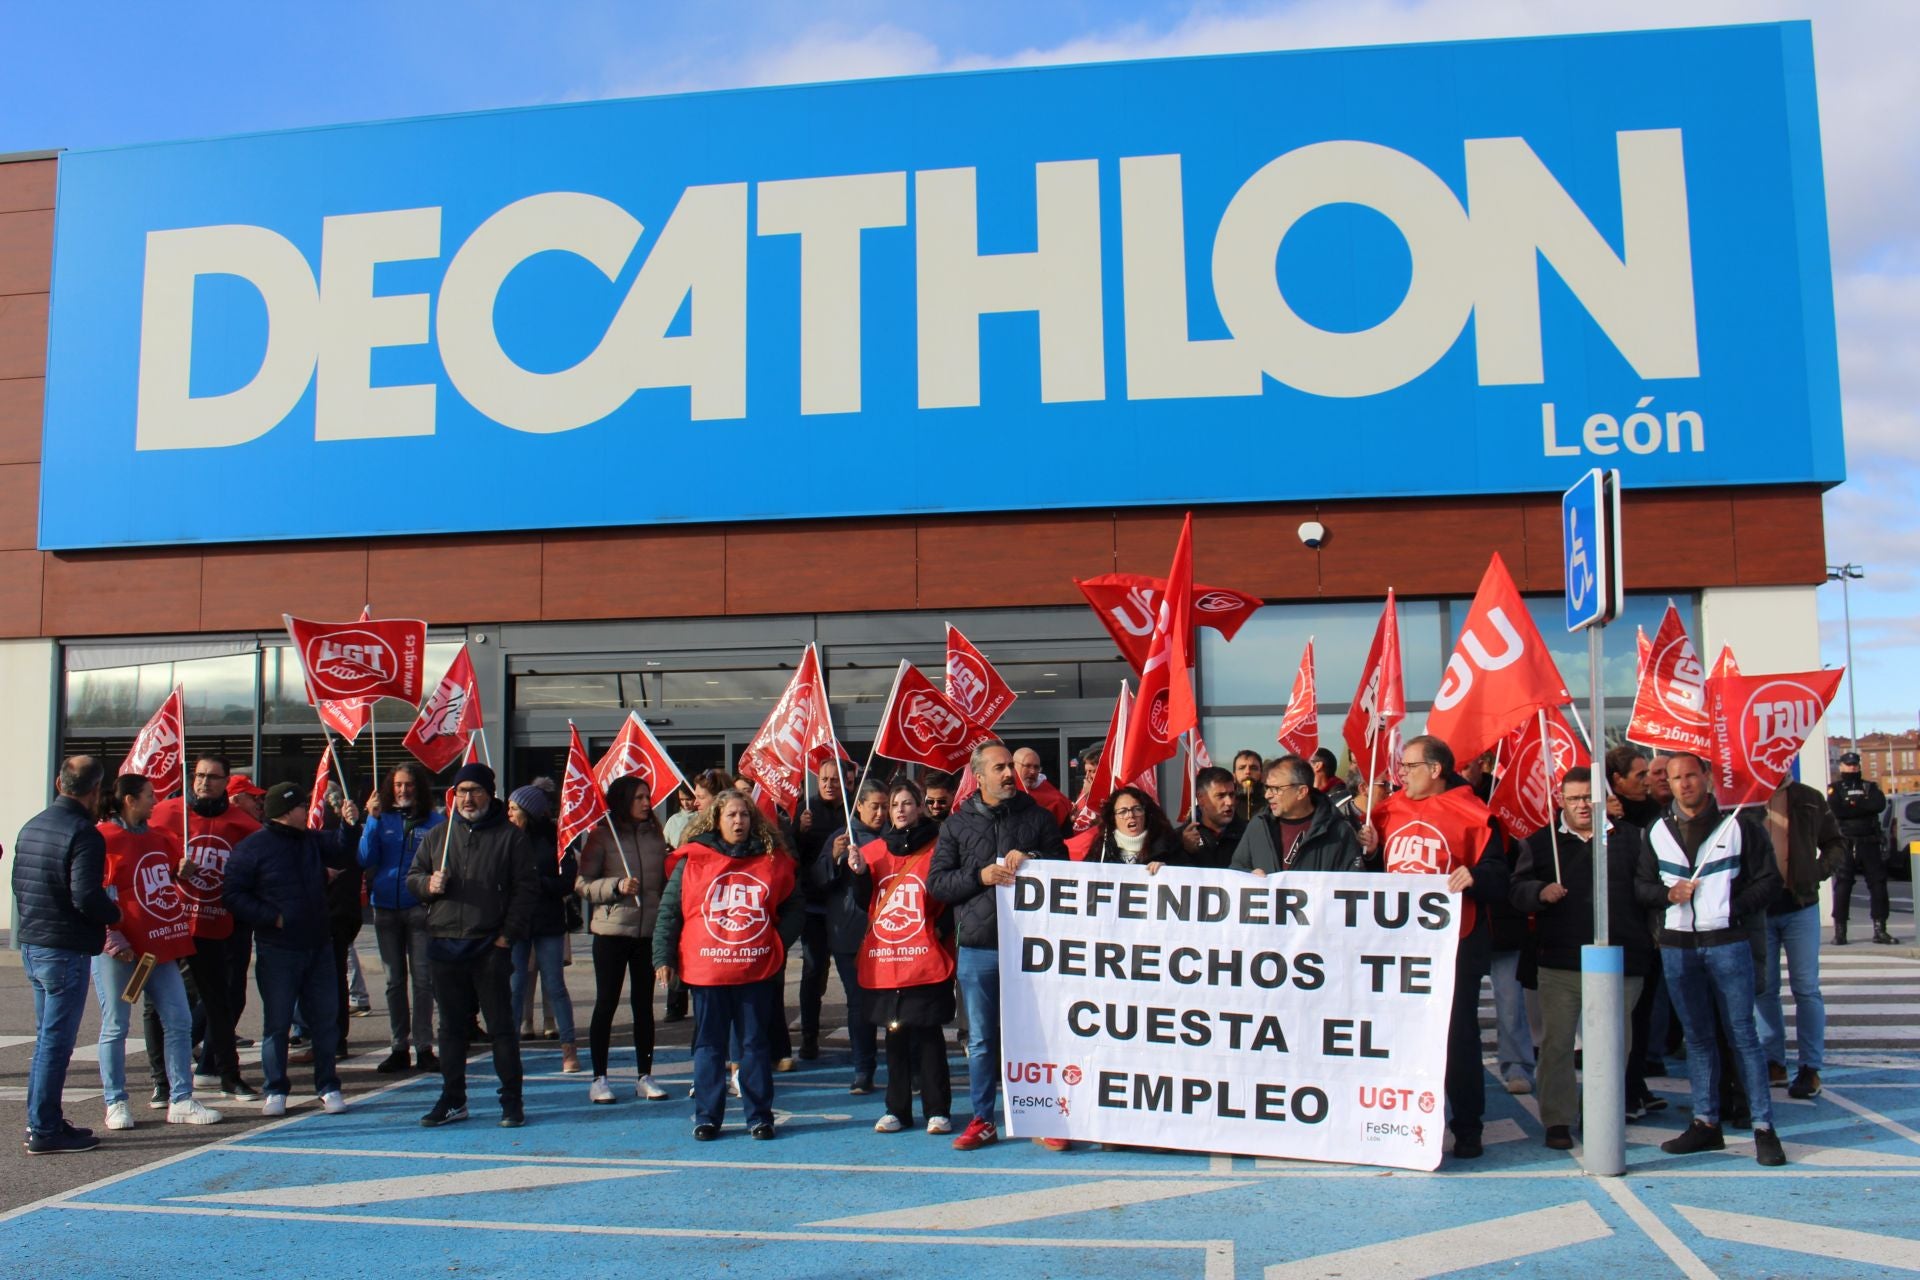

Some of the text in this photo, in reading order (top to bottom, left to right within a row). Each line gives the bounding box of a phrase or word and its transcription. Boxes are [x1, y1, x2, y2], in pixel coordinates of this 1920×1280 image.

[135, 128, 1701, 452] DECATHLON
[1541, 396, 1705, 457] León
[319, 640, 384, 672] UGT
[947, 655, 985, 702] UGT
[910, 694, 963, 737] UGT
[978, 694, 1005, 725] w.ugt.es
[1387, 835, 1442, 868] UGT
[710, 884, 762, 911] UGT
[1014, 876, 1449, 930] DEFENDER TUS
[700, 947, 731, 957] mano
[739, 946, 771, 957] mano
[868, 948, 891, 958] mano
[897, 946, 928, 956] mano
[1021, 937, 1432, 994] DERECHOS TE
[1067, 1001, 1390, 1058] CUESTA EL
[1007, 1062, 1058, 1084] UGT
[1012, 1096, 1054, 1108] FeSMC
[1098, 1071, 1329, 1124] EMPLEO
[1359, 1086, 1414, 1111] UGT
[1366, 1122, 1409, 1136] FeSMC
